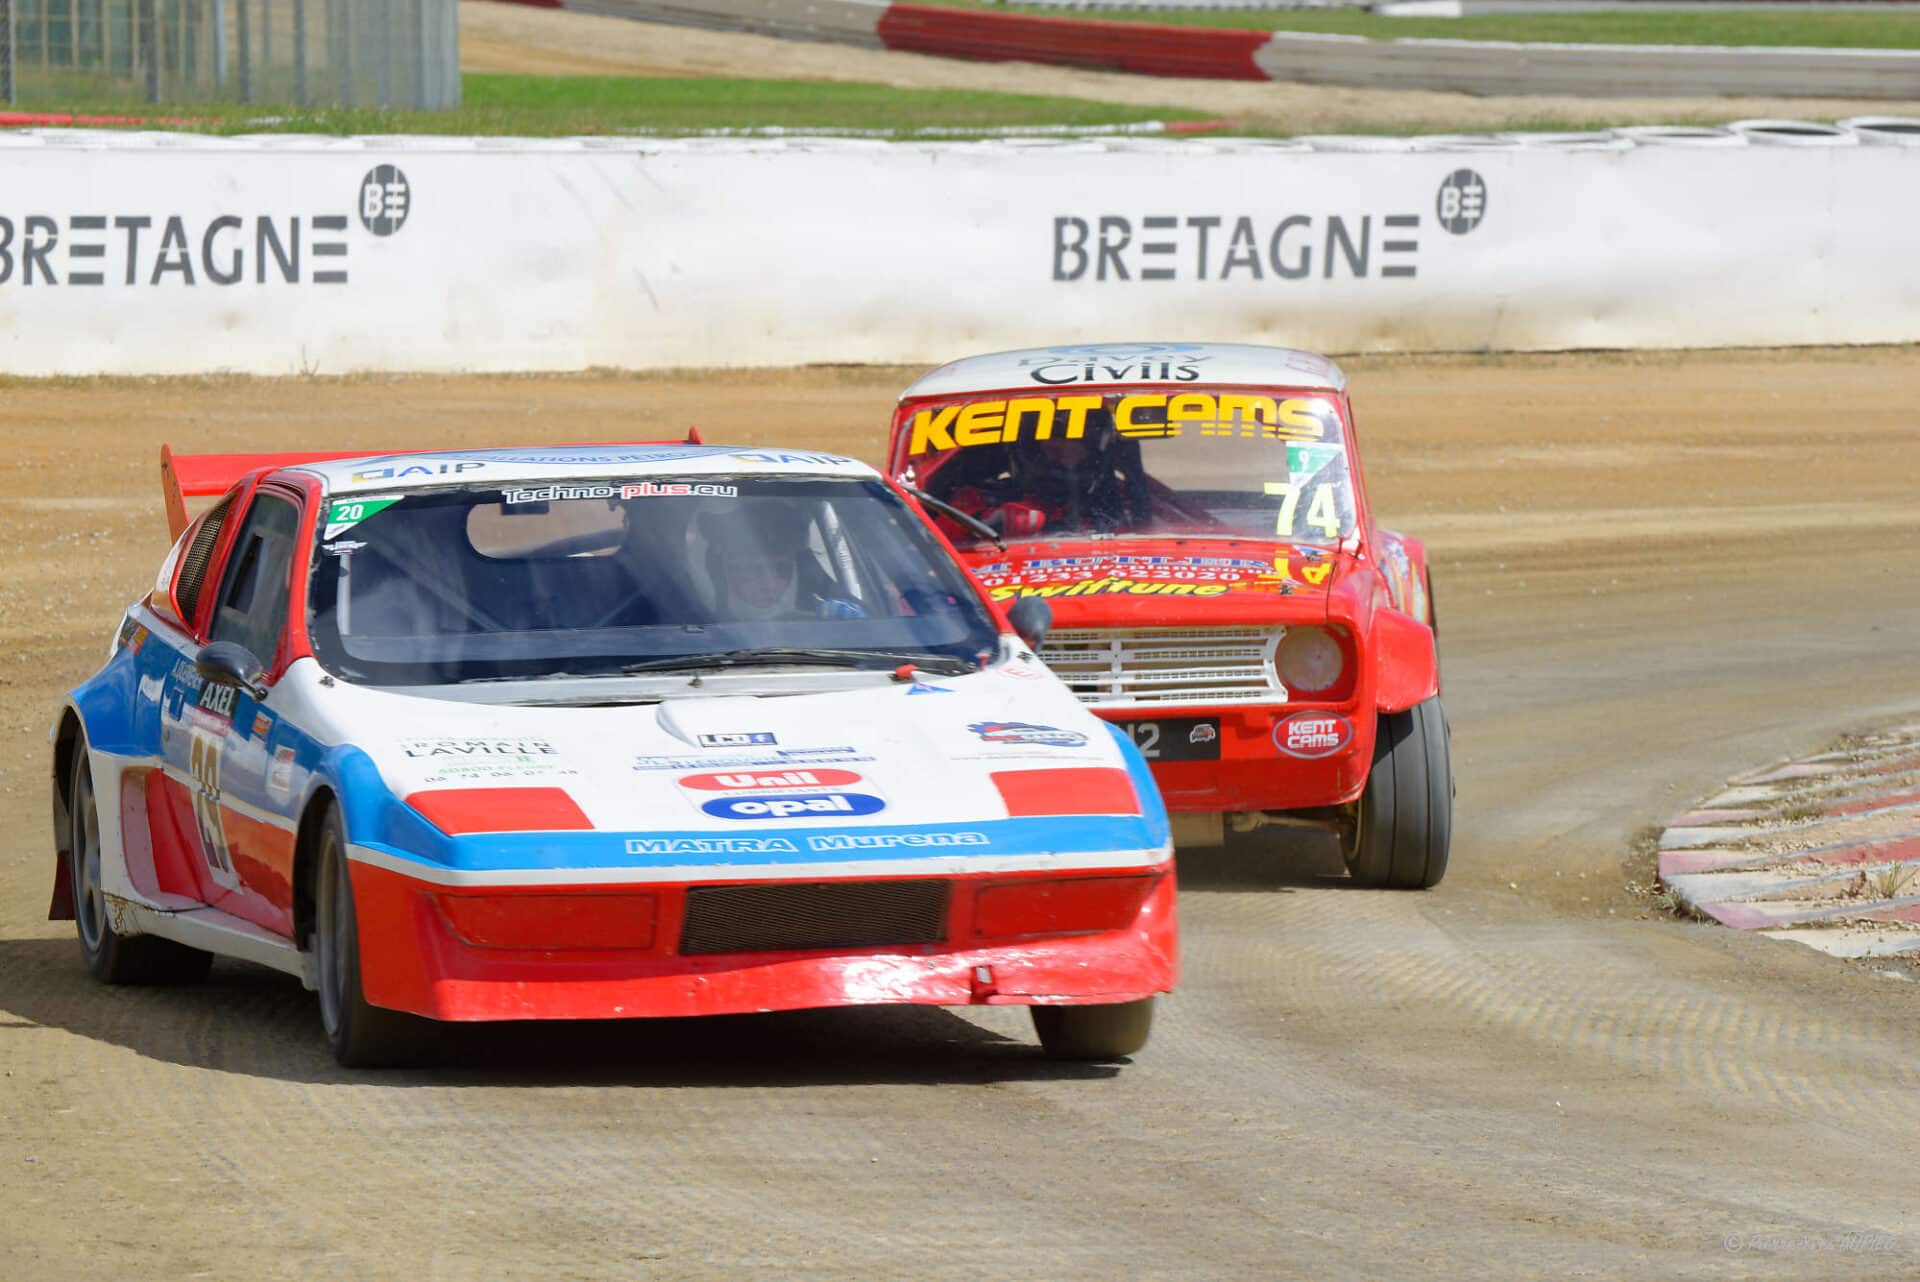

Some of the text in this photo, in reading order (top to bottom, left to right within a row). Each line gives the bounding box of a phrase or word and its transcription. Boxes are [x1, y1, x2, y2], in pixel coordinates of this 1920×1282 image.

[1052, 214, 1420, 281] BRETAGNE
[1030, 361, 1200, 385] Civils
[909, 393, 1325, 456] KENT CAMS
[397, 461, 486, 478] AIP
[502, 482, 739, 504] Techno-plus.eu
[336, 503, 365, 523] 20
[1264, 482, 1341, 538] 74
[983, 570, 1093, 586] 01233
[988, 576, 1229, 602] Swiftune
[200, 680, 236, 717] AXEL
[1288, 720, 1337, 735] KENT
[404, 746, 561, 758] LAVILLE
[1287, 733, 1340, 749] CAMS
[714, 771, 822, 788] Unil
[730, 795, 855, 817] opal
[624, 832, 991, 854] MATRA Murena
